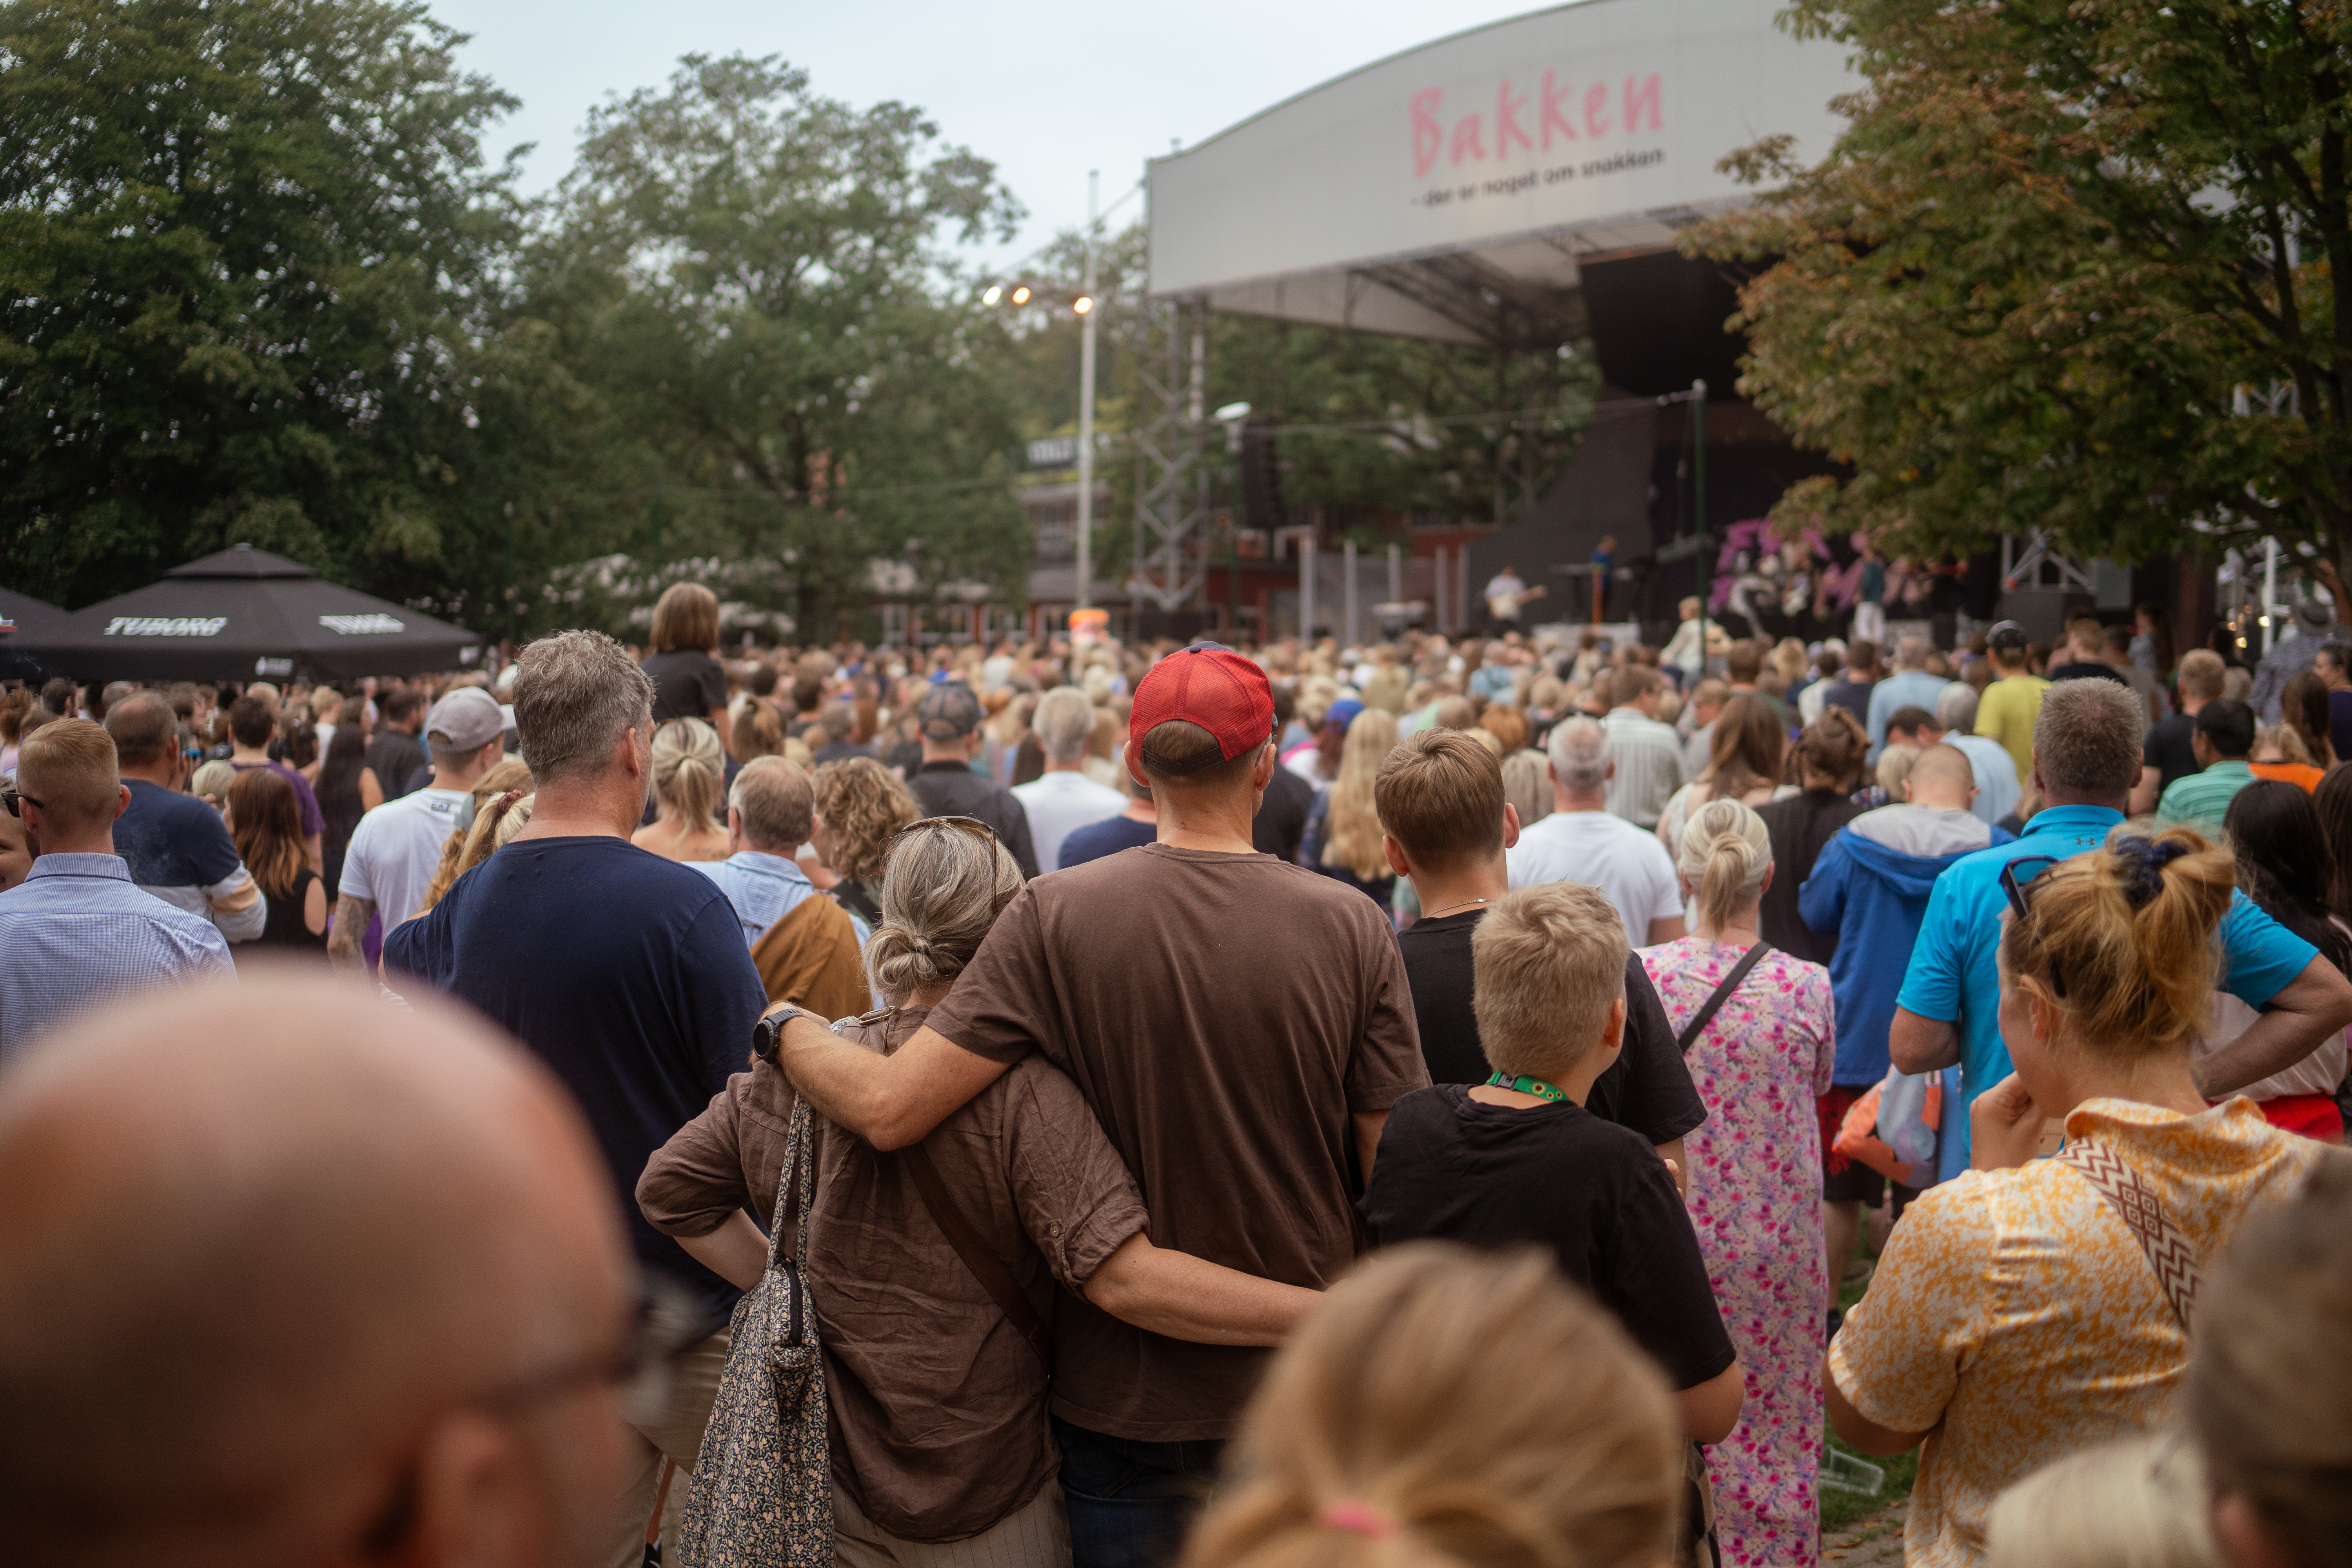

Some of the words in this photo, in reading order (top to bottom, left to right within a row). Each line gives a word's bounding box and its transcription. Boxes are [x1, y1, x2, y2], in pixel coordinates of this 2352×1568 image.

[1410, 67, 1662, 180] Bakken
[1544, 165, 1575, 185] om
[103, 617, 228, 636] TUBORG
